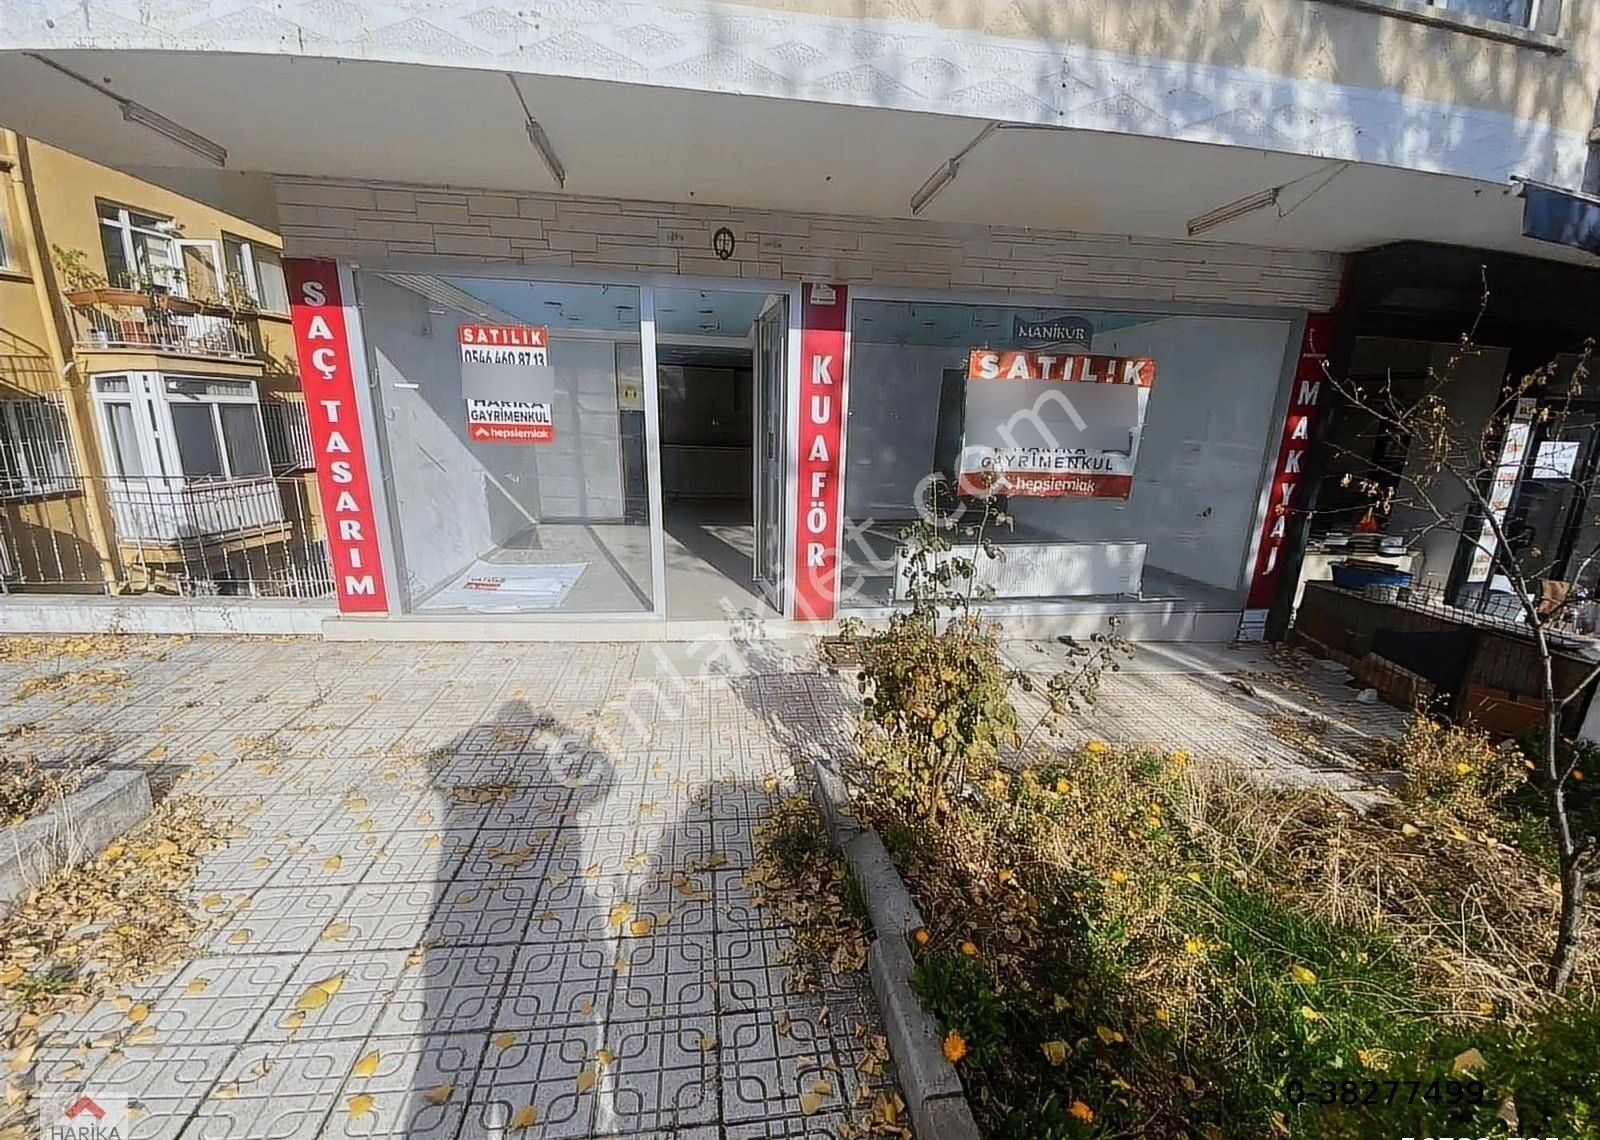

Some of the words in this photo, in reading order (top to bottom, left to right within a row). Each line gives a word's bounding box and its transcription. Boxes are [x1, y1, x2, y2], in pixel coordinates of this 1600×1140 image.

[463, 328, 542, 345] SATILIK
[471, 408, 549, 423] GAYRİMENKUL
[302, 281, 337, 380] SAÇ
[320, 400, 376, 595] TASARIM
[491, 427, 548, 438] hepsiemlak
[807, 355, 833, 567] KUAFÖR
[1016, 477, 1096, 492] hepsiemlak
[1262, 380, 1321, 575] MAKYAJ
